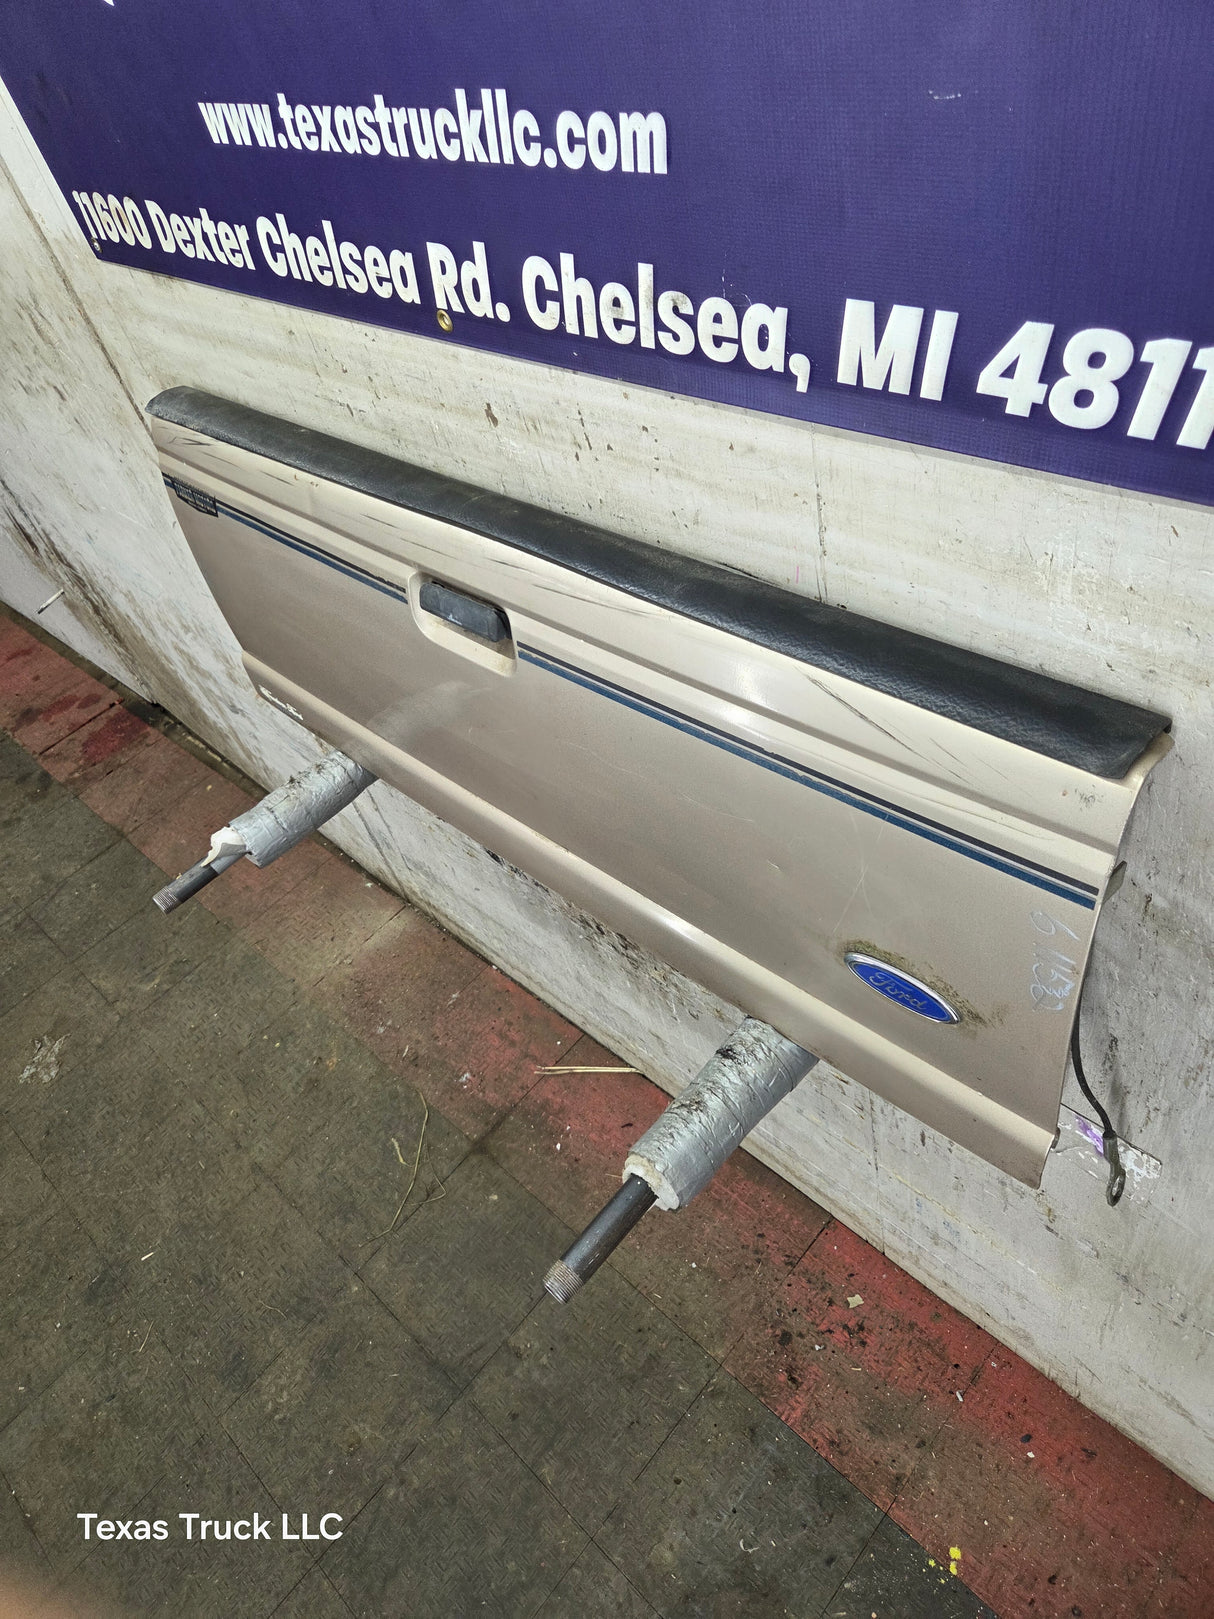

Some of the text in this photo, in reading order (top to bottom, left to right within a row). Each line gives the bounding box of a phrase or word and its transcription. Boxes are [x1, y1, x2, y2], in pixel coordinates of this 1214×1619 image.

[198, 87, 669, 175] www.texastruckllc.com
[72, 190, 152, 250] 11600
[144, 199, 255, 271] Dexter
[256, 212, 421, 305] Chelsea
[426, 241, 511, 323] Rd.
[522, 251, 811, 394] Chelsea,
[836, 297, 959, 401] MI
[868, 971, 928, 1010] Ford
